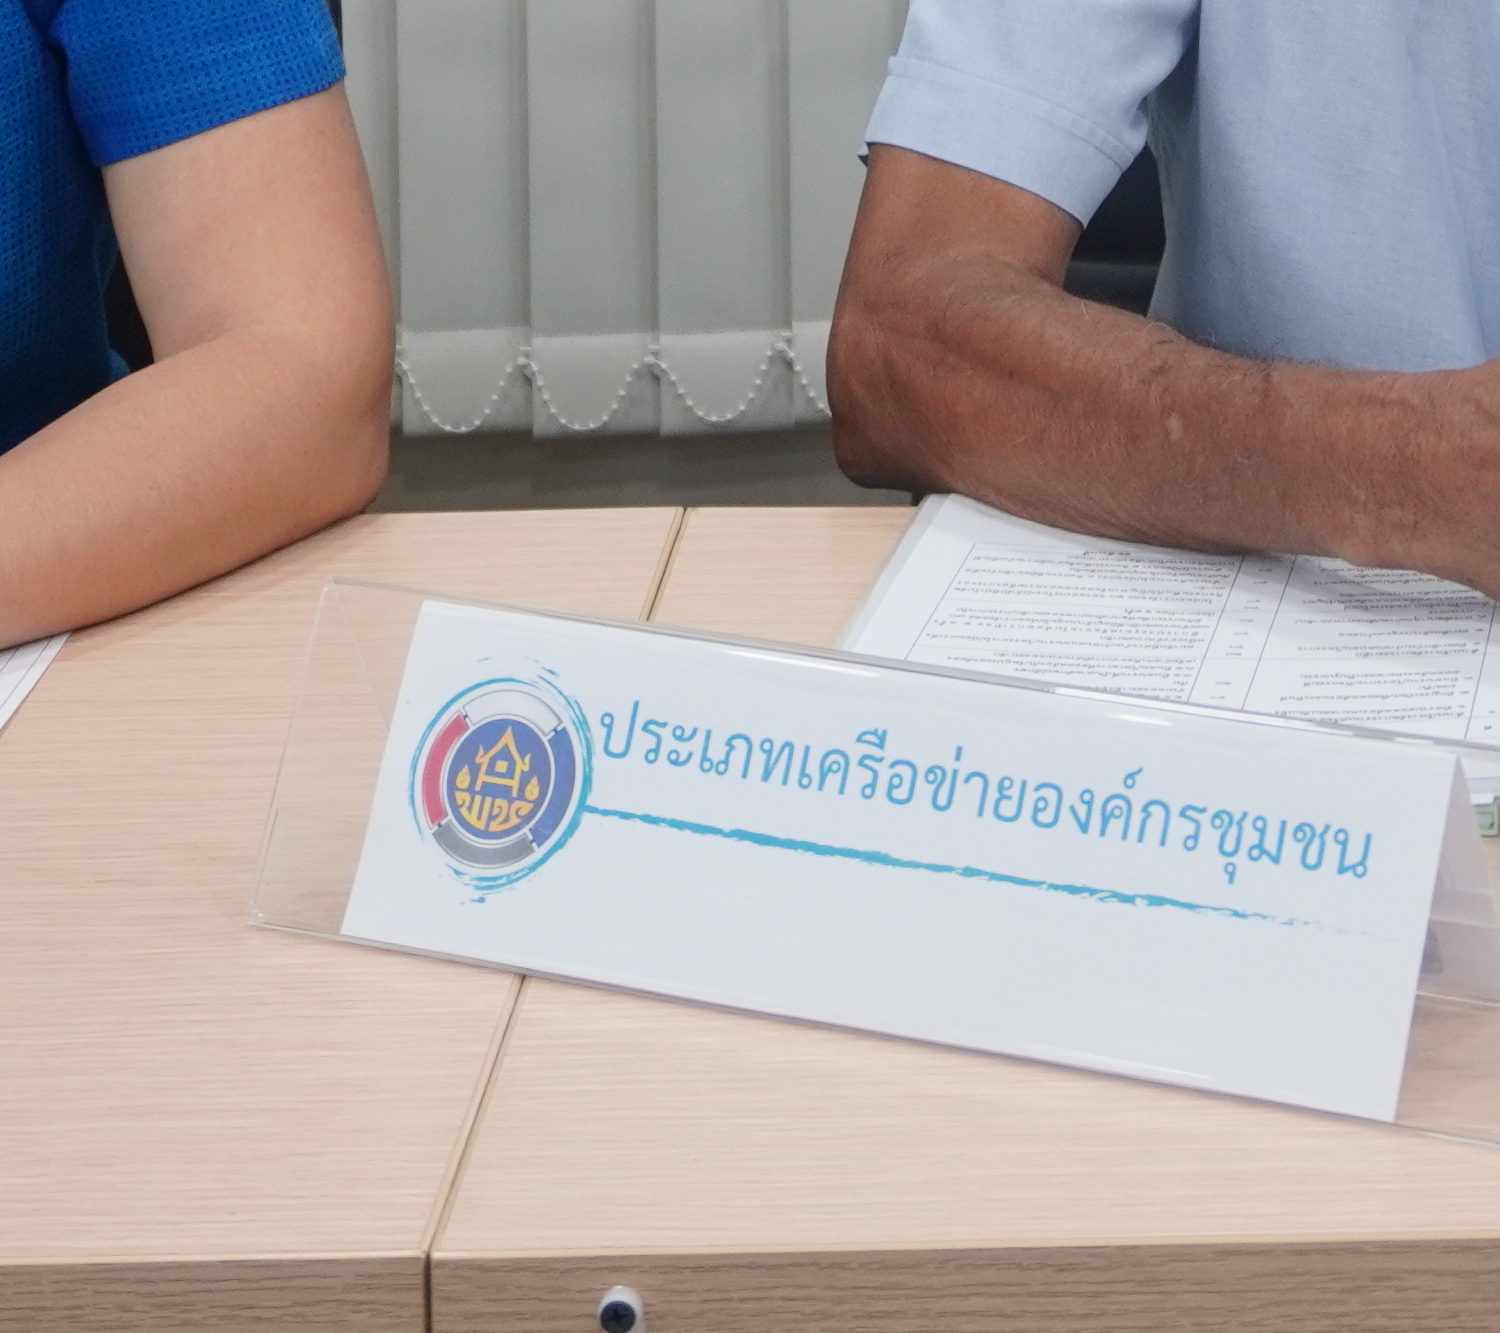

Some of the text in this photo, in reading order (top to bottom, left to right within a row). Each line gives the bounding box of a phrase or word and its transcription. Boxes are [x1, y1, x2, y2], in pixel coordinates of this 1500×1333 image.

[599, 700, 1375, 884] ประเภทเครือข่ายองค์กรชุมชน
